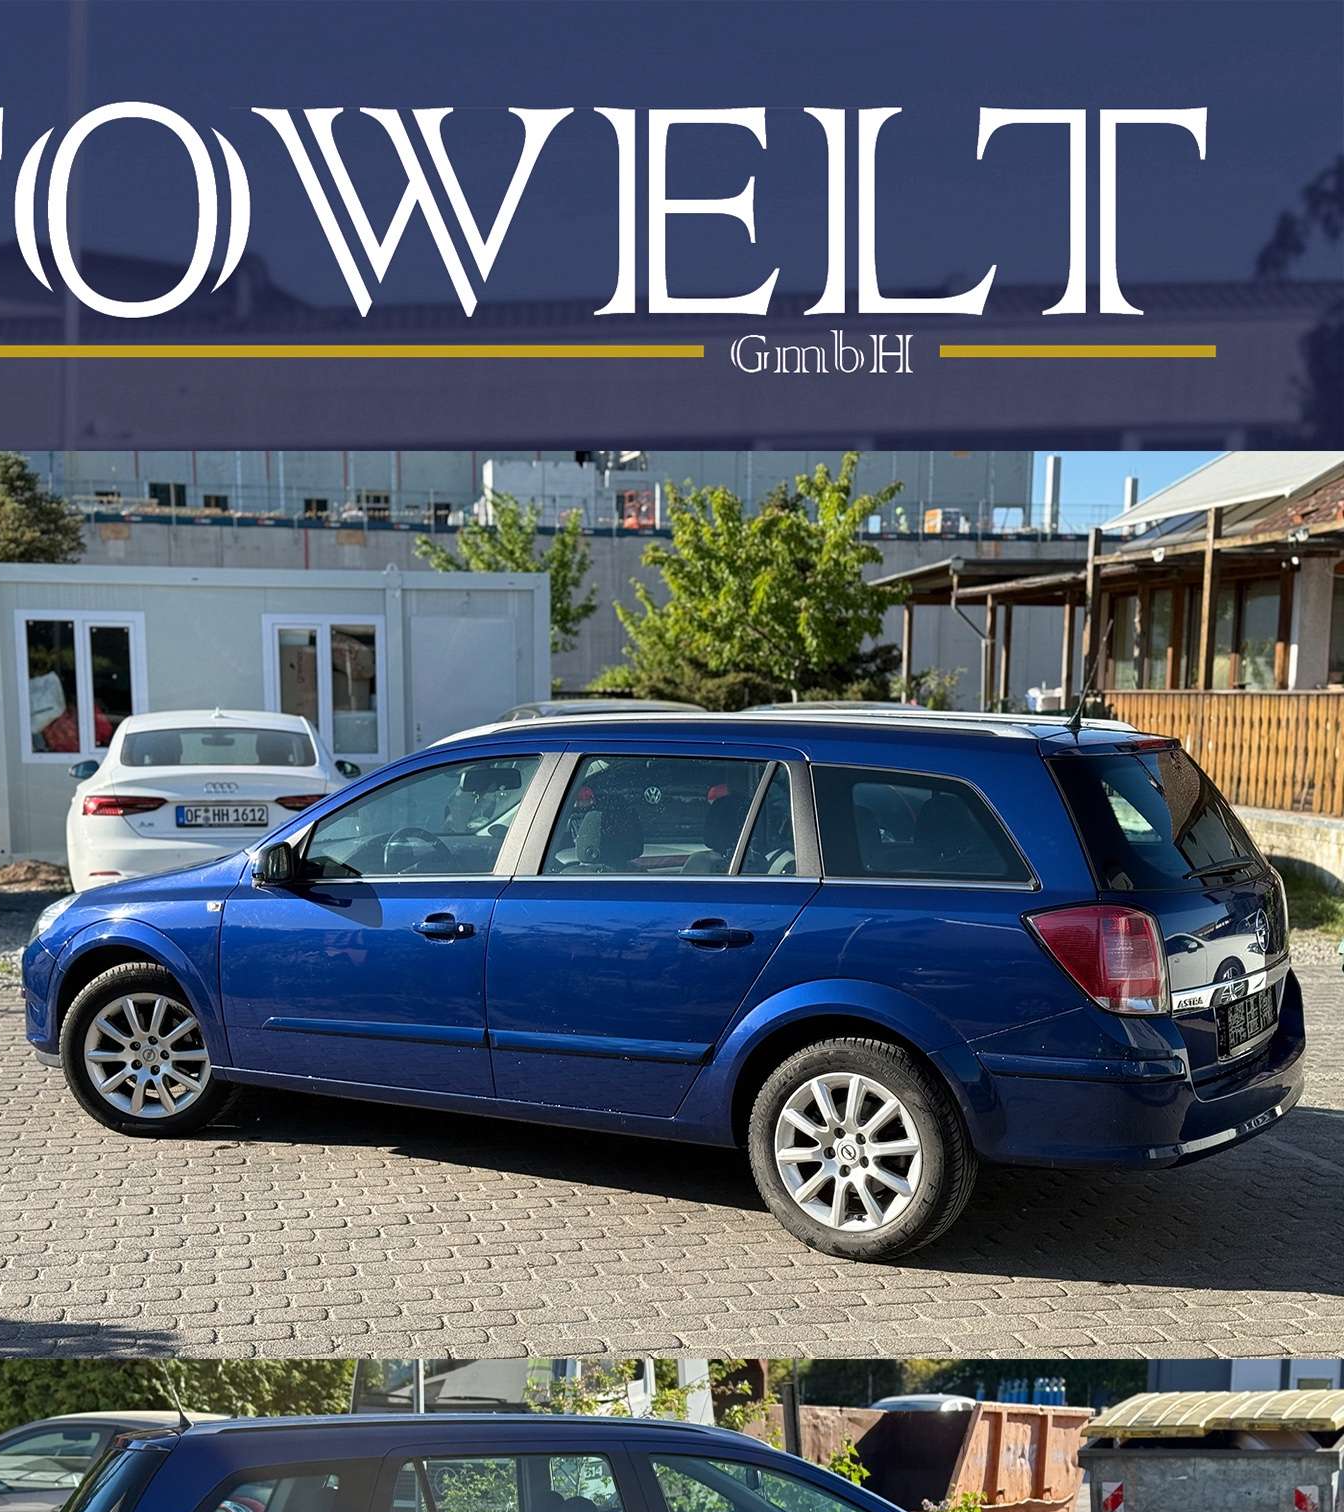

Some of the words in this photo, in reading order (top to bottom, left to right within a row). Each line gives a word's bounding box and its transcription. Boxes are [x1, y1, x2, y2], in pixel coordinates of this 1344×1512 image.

[185, 808, 201, 822] OF
[212, 808, 229, 822] HH
[232, 808, 265, 822] 1612
[1177, 996, 1204, 1008] ASTRA
